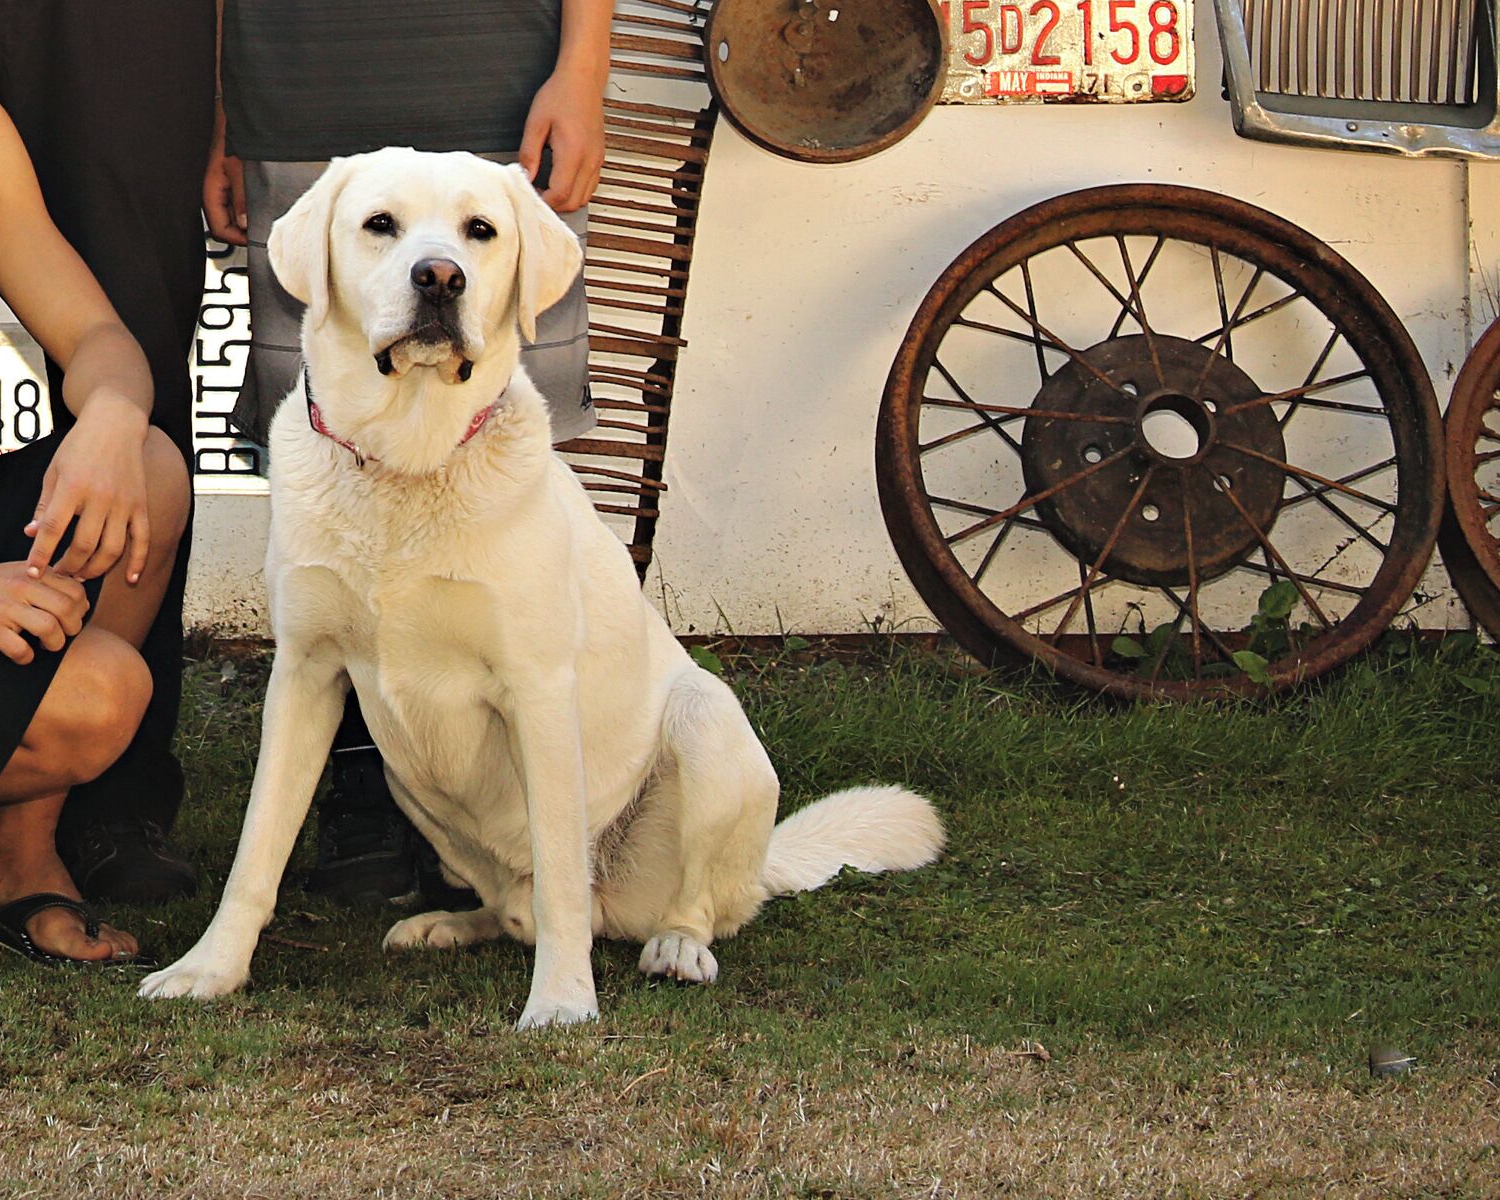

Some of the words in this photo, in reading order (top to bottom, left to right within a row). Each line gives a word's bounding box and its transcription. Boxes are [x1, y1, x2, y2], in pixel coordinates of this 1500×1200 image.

[940, 0, 1181, 67] 5D2158
[999, 71, 1029, 92] MAY
[1036, 72, 1069, 80] INDIANA
[1086, 73, 1109, 94] 71
